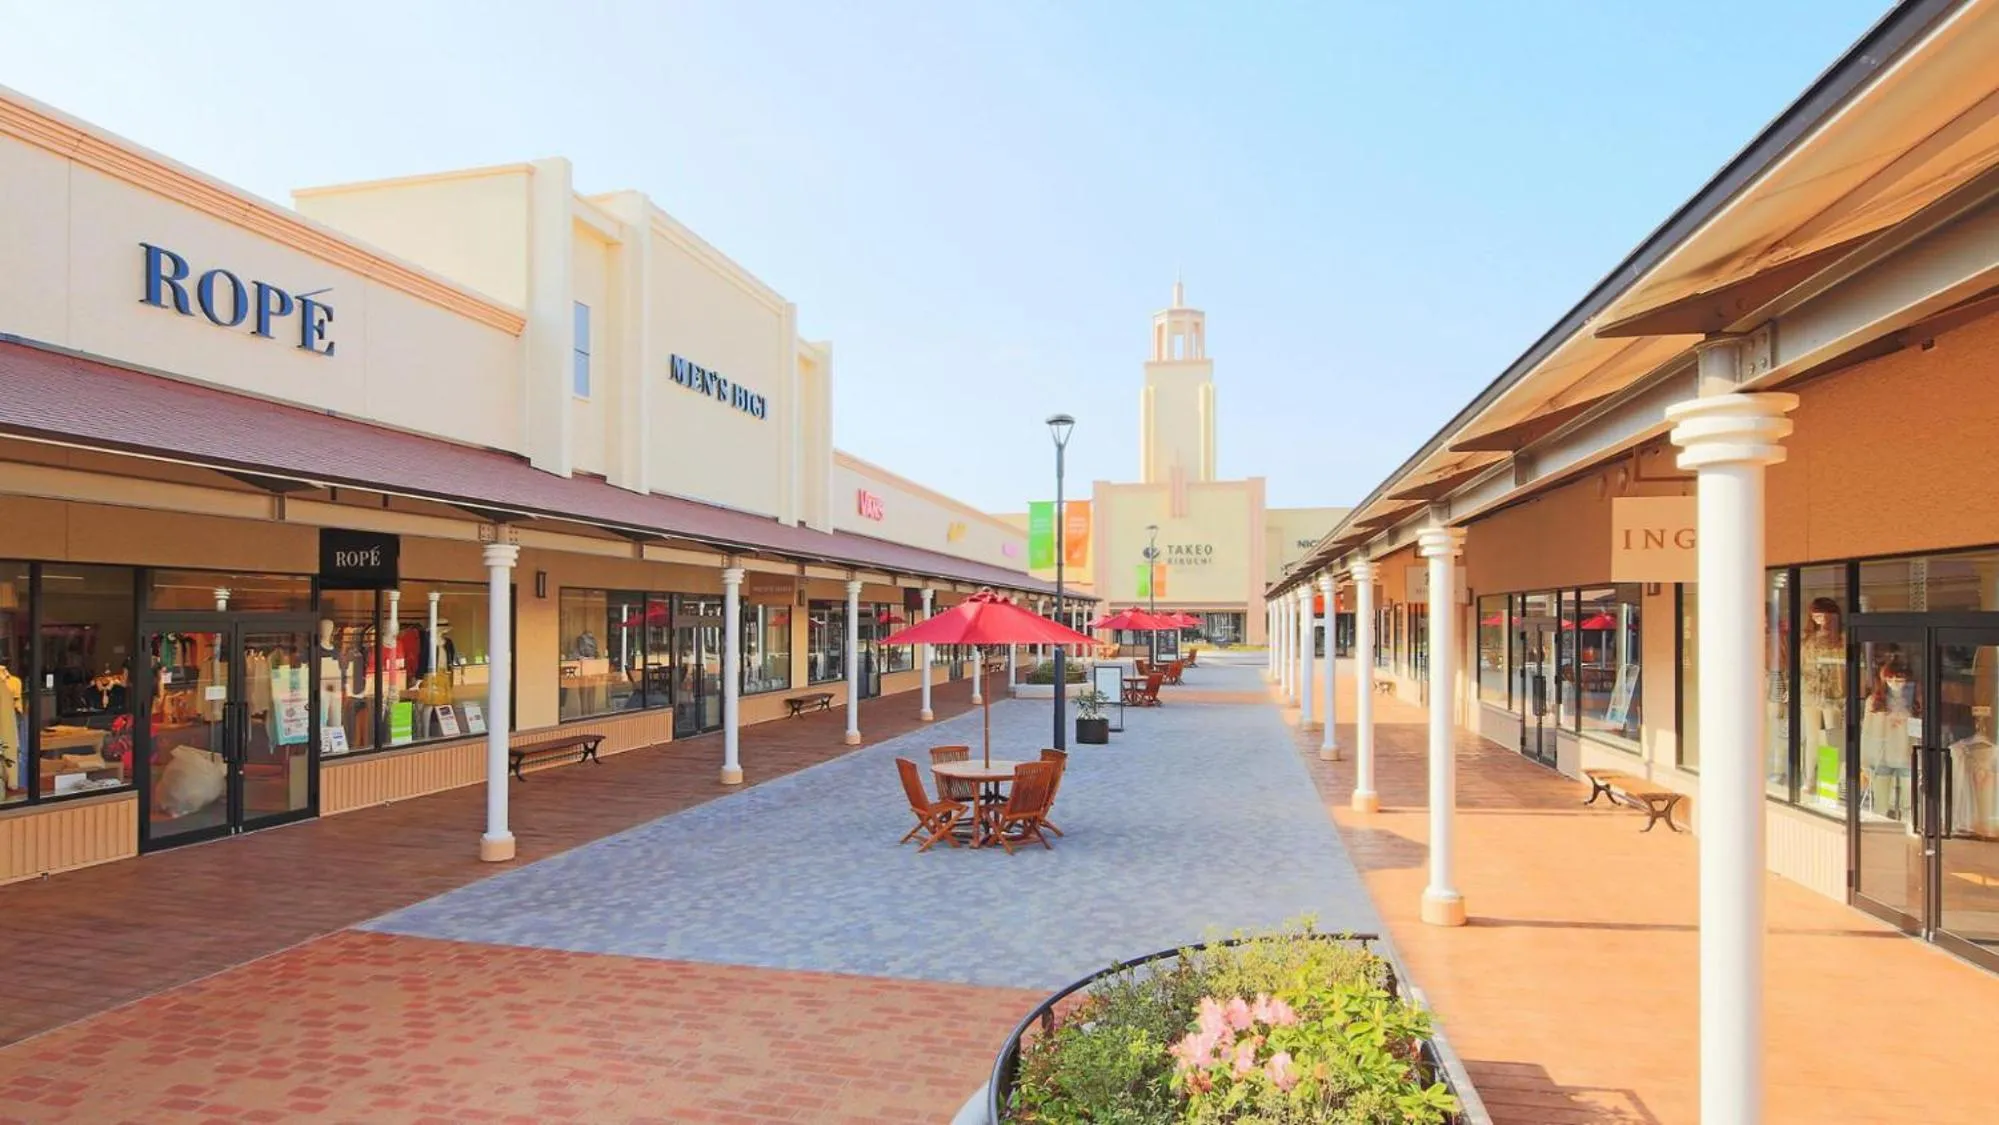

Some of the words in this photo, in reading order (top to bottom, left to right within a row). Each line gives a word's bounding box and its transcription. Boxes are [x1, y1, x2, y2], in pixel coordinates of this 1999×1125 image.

[138, 241, 336, 356] ROPÉ
[668, 353, 728, 402] MEN'S
[731, 383, 768, 420] BIGI
[857, 488, 883, 520] VANS
[1167, 544, 1213, 555] TAKEO
[1623, 528, 1696, 549] ING
[336, 545, 381, 567] ROPÉ
